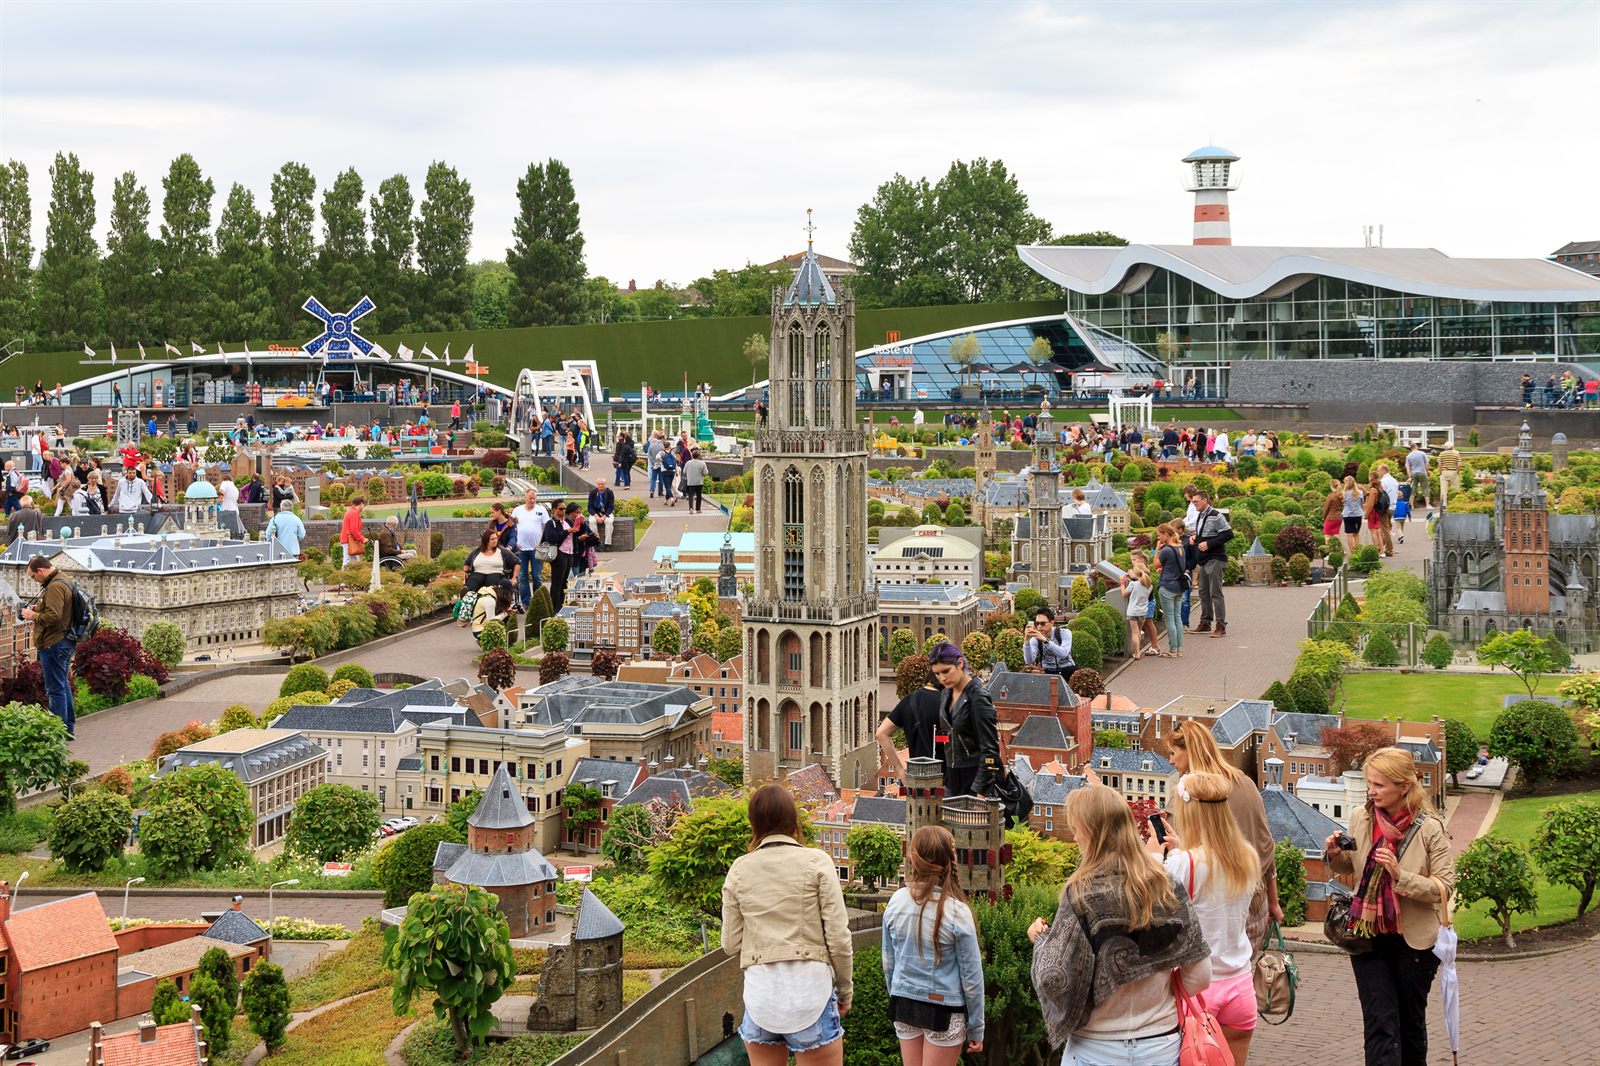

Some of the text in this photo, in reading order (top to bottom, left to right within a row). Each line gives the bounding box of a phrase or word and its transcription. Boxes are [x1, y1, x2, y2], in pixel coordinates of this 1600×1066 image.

[268, 344, 299, 358] Shop
[873, 344, 914, 355] Taste of
